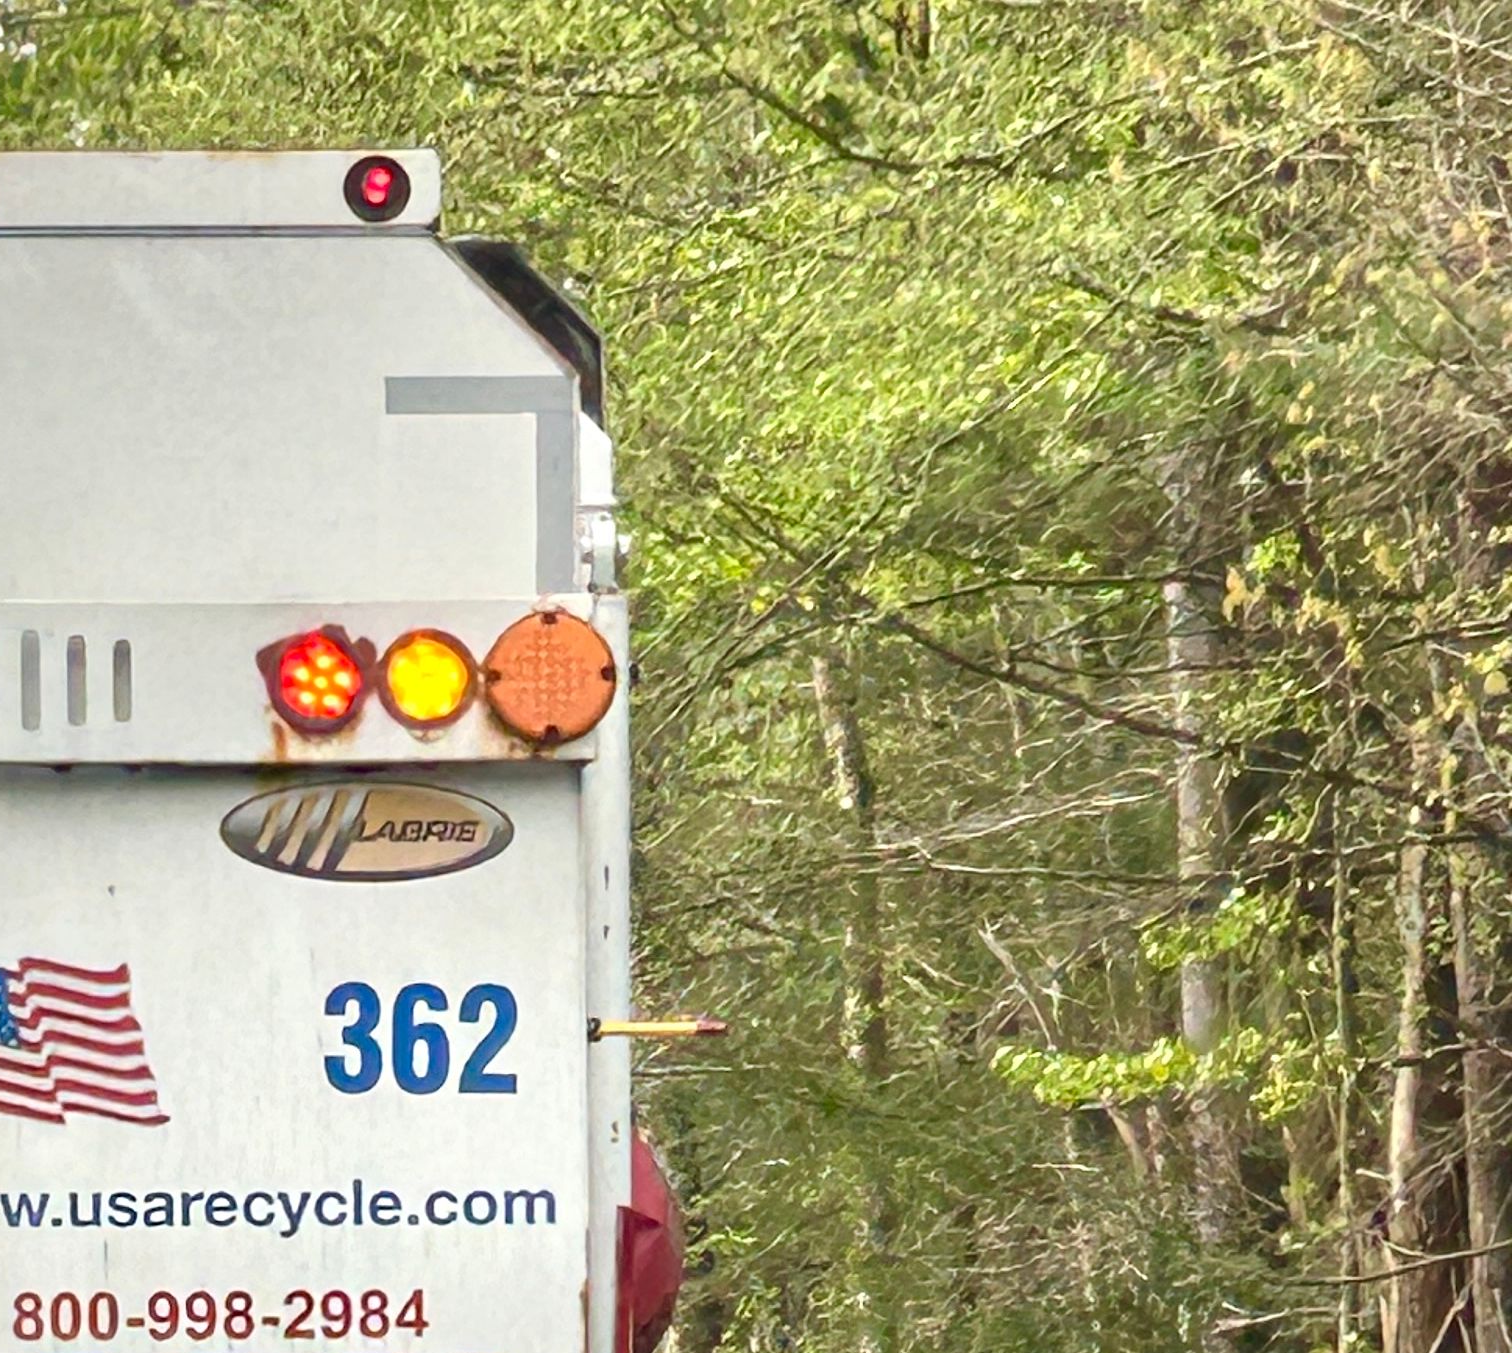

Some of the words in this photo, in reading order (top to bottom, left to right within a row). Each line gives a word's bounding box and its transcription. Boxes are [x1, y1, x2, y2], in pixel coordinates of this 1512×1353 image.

[354, 819, 480, 843] LABRIE
[324, 981, 518, 1095] 362
[13, 1288, 430, 1341] 800-998-2984
